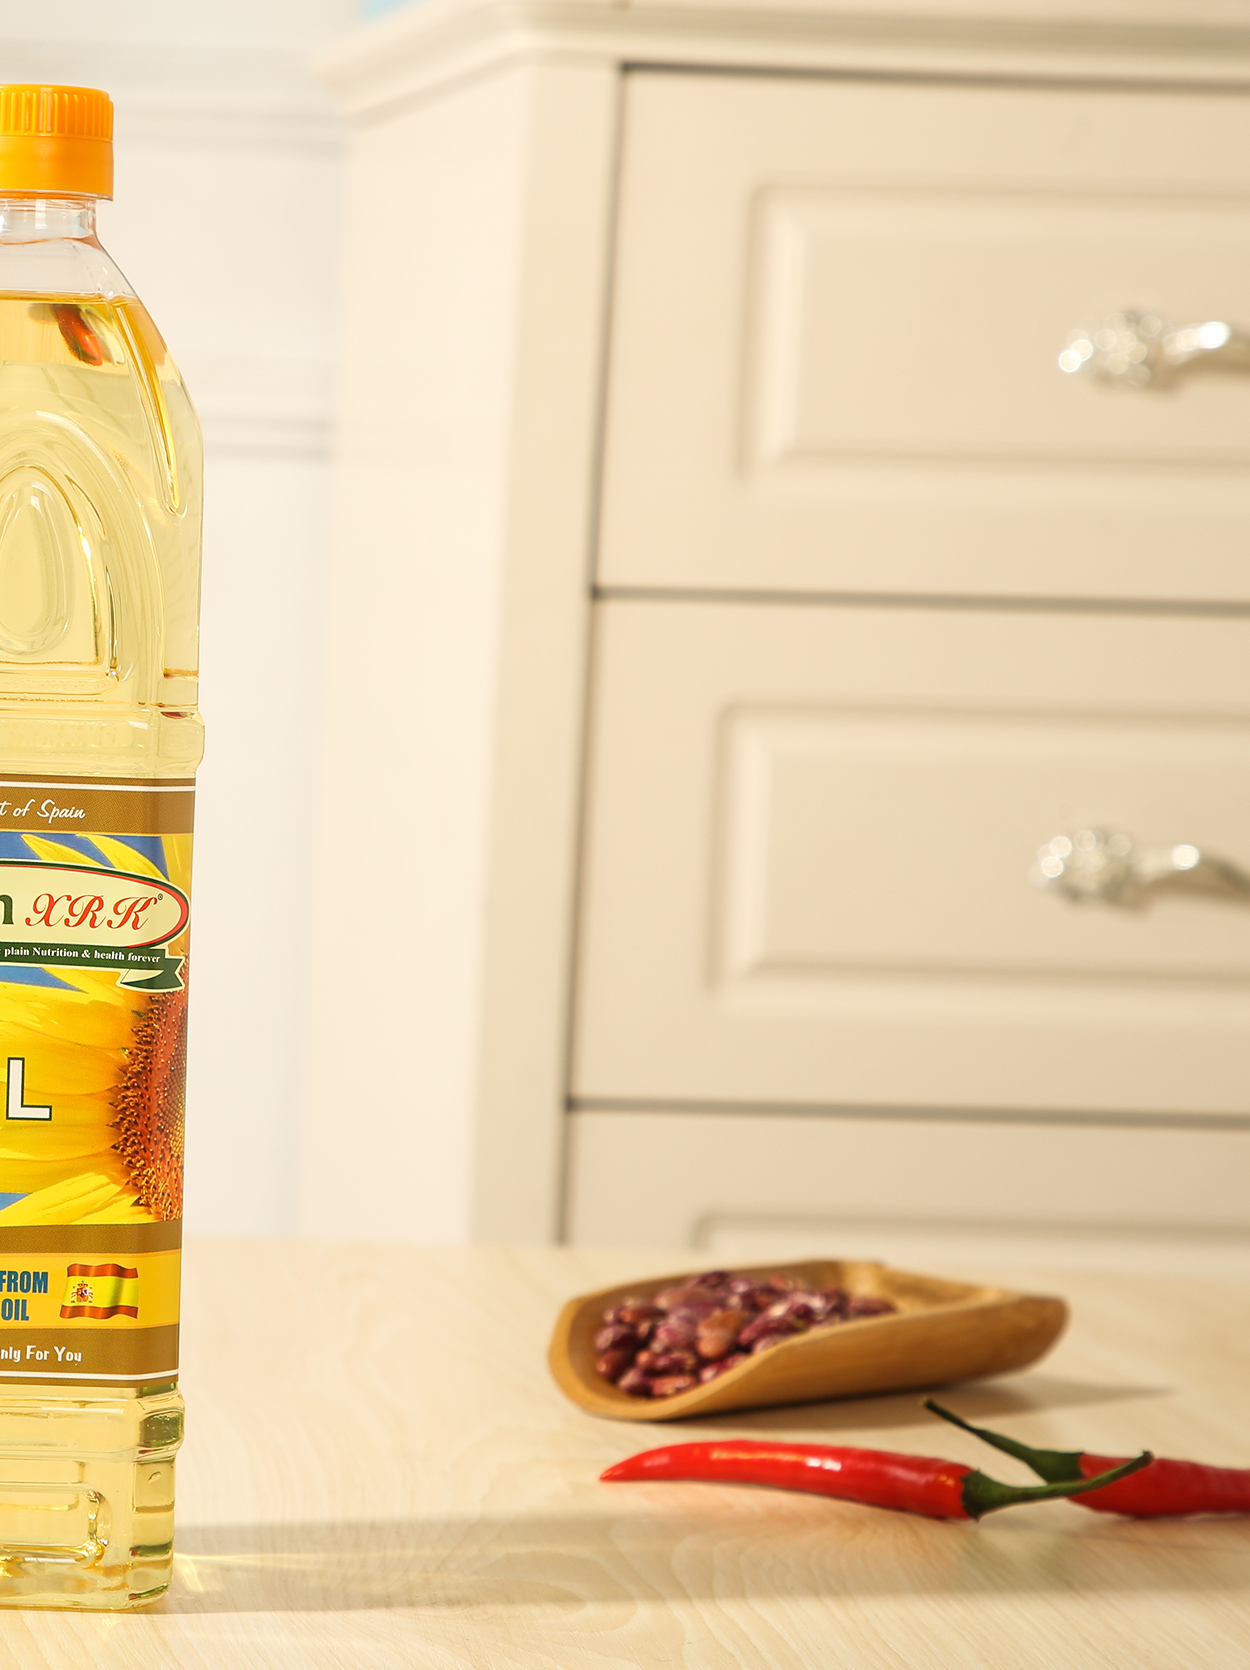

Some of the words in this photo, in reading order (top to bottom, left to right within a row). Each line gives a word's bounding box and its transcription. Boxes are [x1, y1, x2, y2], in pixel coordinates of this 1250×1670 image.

[12, 799, 35, 817] of
[36, 799, 86, 824] Spain
[4, 946, 30, 957] plain
[32, 947, 79, 958] Nutrition
[81, 949, 91, 959] &
[94, 950, 125, 961] health
[127, 952, 161, 963] forever
[0, 1298, 30, 1321] OIL
[25, 1345, 50, 1360] For
[53, 1346, 83, 1362] You
